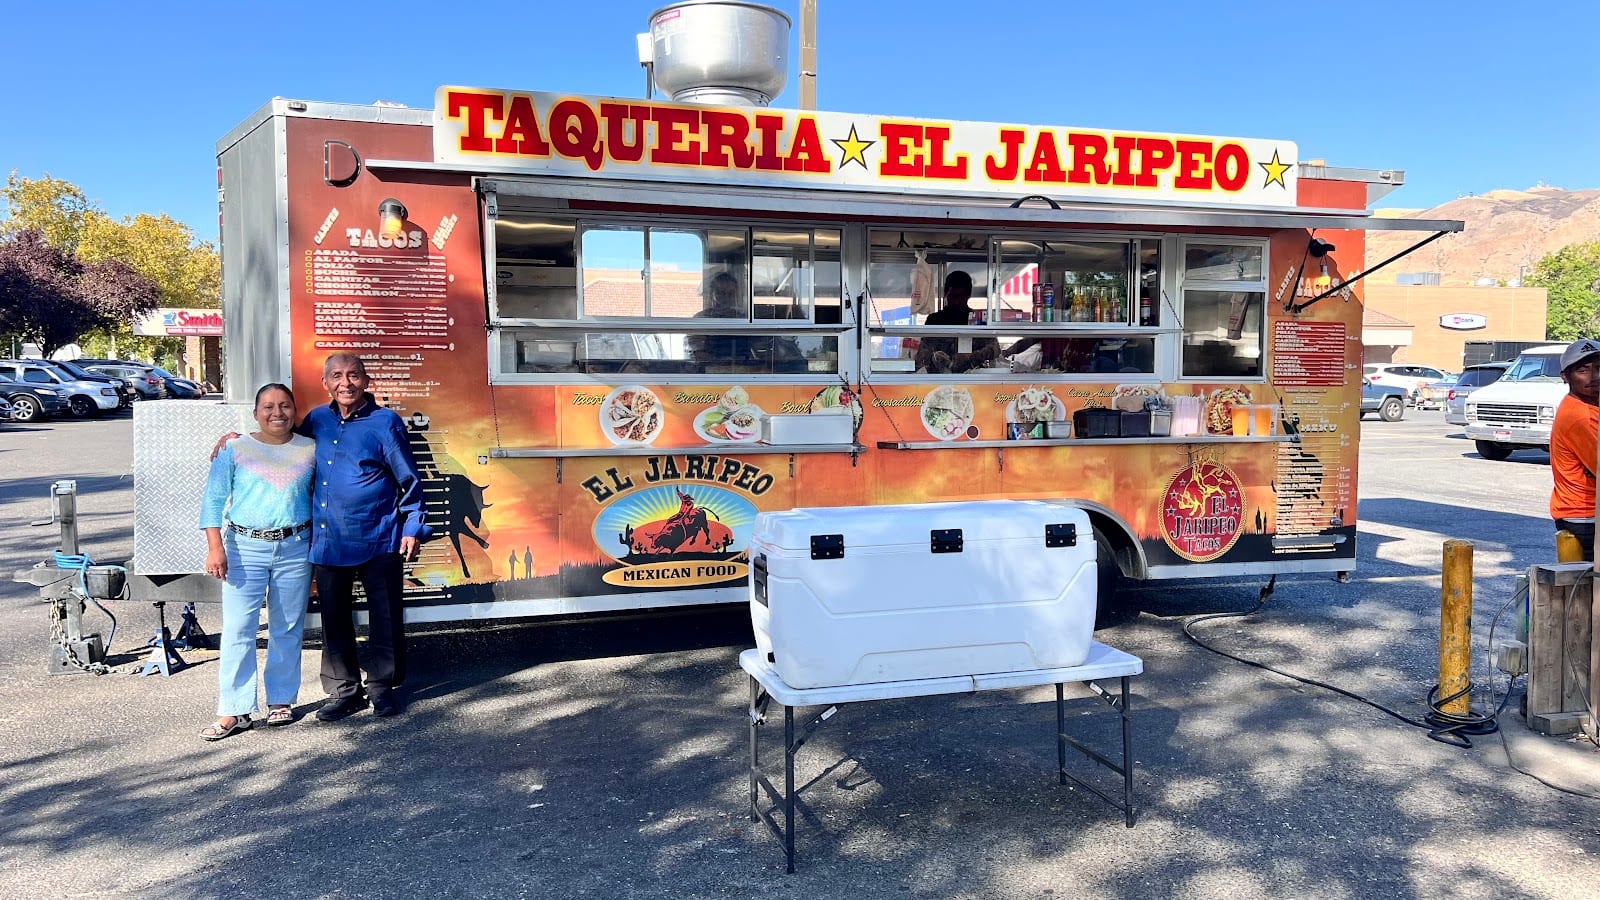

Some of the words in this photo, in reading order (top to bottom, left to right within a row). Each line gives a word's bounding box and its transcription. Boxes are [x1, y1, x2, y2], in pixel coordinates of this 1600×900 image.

[446, 90, 833, 174] TAQUERIA
[879, 122, 968, 180] EL
[985, 128, 1250, 192] JARIPEO
[346, 227, 422, 249] TACOS
[334, 256, 384, 264] PASTOR
[314, 282, 372, 290] CHORIZO
[314, 289, 399, 297] CHICHARRON
[315, 321, 377, 329] SUADERO
[573, 392, 607, 405] Tacos
[871, 394, 924, 408] Quesadillas
[1300, 422, 1338, 433] MENU
[580, 466, 635, 504] EL
[644, 453, 776, 497] JARIPEO
[1211, 495, 1230, 516] EL
[1169, 515, 1237, 541] JARIPEO
[1183, 535, 1222, 555] TACOS
[623, 567, 691, 582] MEXICAN
[696, 564, 738, 578] FOOD
